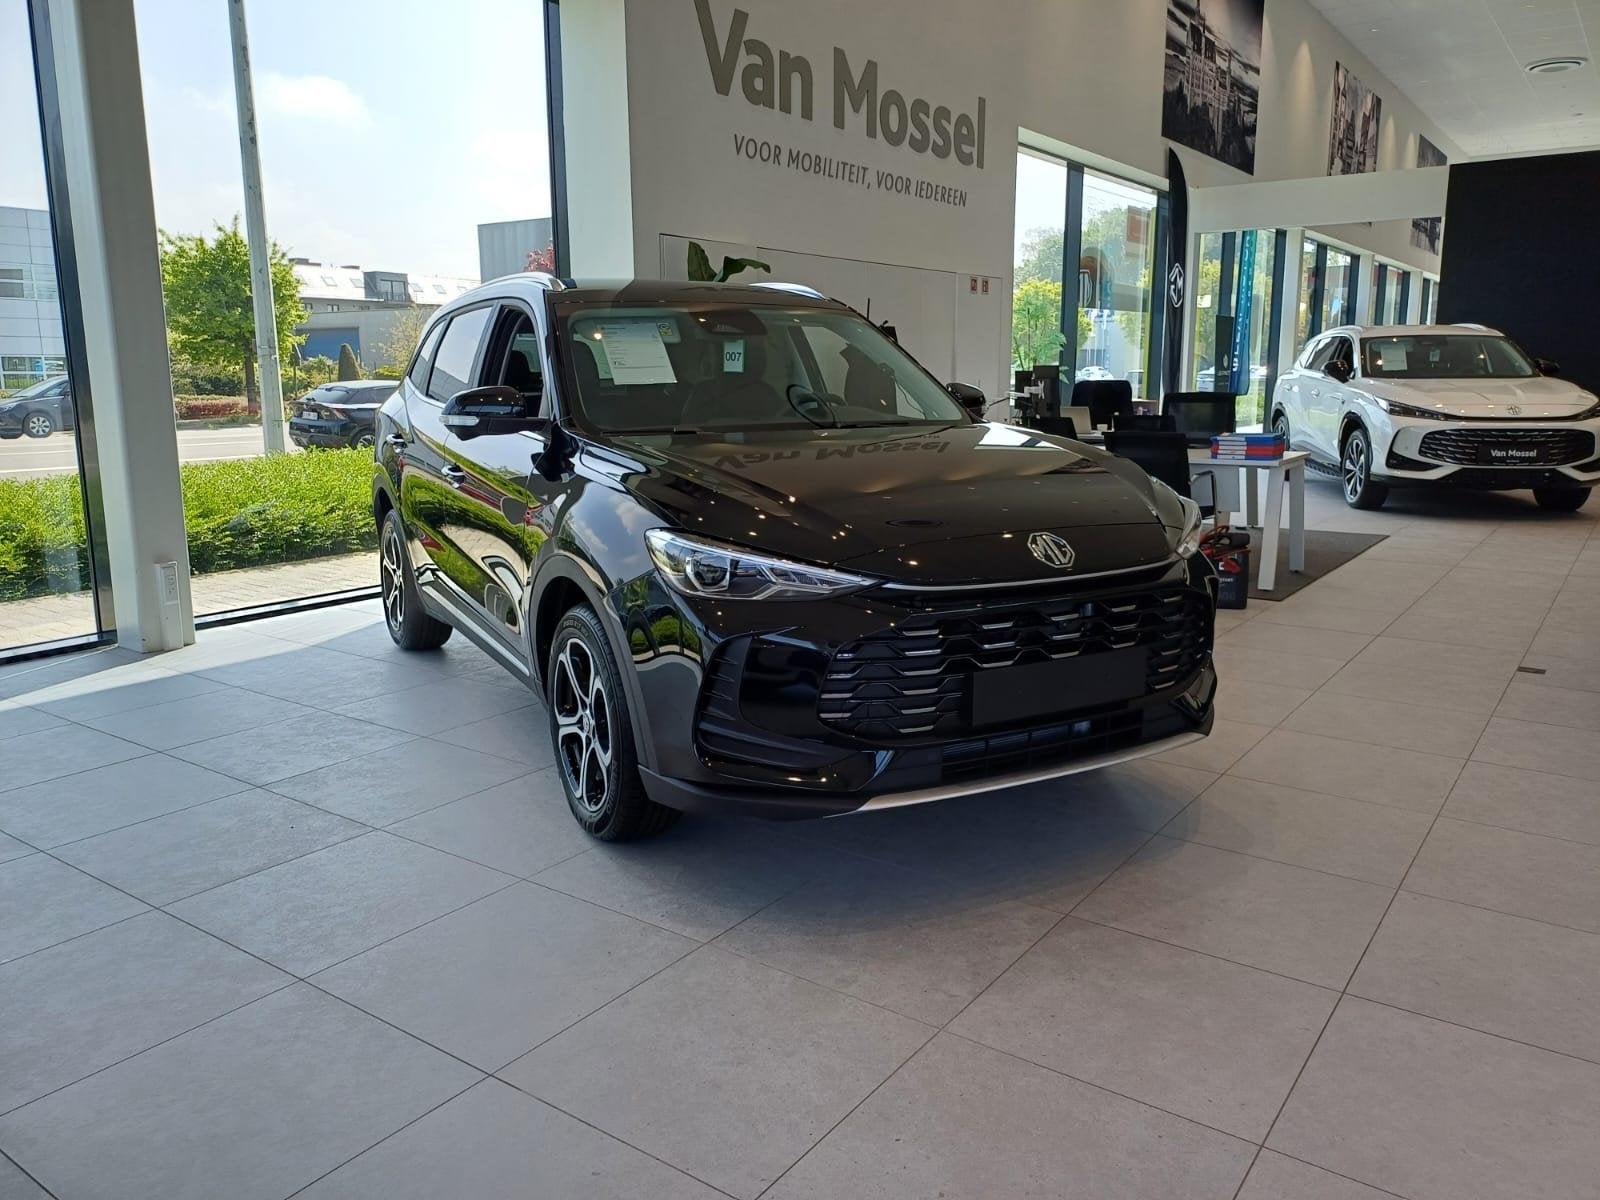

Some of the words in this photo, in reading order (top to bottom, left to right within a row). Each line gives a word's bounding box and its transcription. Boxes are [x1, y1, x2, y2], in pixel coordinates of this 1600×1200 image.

[694, 0, 813, 121] Van
[833, 46, 986, 169] Mossel
[733, 133, 782, 166] VOOR
[787, 148, 871, 190] MOBILITEIT,
[876, 170, 912, 196] VOOR
[914, 178, 968, 208] IEDEREEN
[725, 351, 742, 362] 007
[1490, 449, 1506, 457] Van
[1508, 449, 1537, 457] Mossel
[1030, 533, 1072, 565] MG
